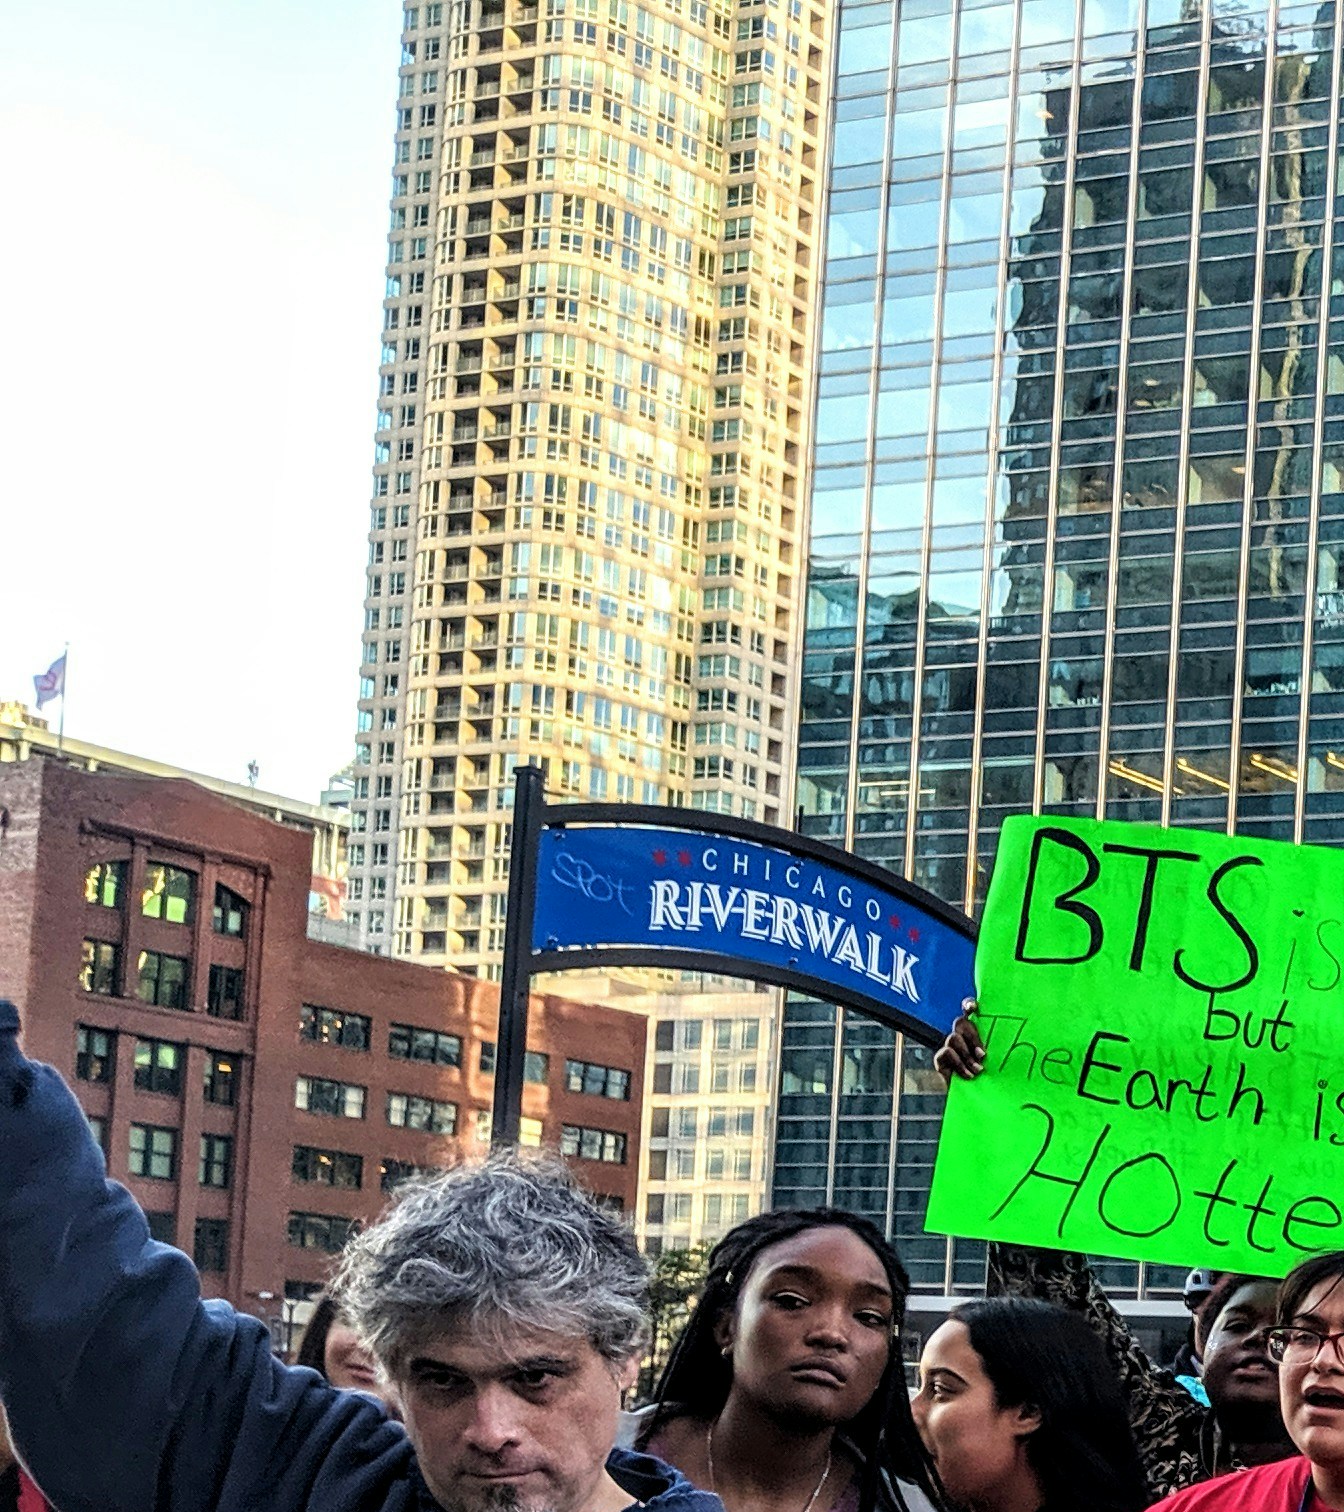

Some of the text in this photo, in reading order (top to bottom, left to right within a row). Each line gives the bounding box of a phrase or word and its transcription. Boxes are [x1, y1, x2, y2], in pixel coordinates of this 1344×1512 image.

[703, 848, 880, 922] CHICAGO
[1014, 827, 1265, 993] BTS
[1282, 910, 1343, 994] is
[649, 879, 920, 1003] RIVERWALK
[977, 1014, 1073, 1085] The
[1076, 1031, 1265, 1125] Earth
[1204, 992, 1295, 1052] but
